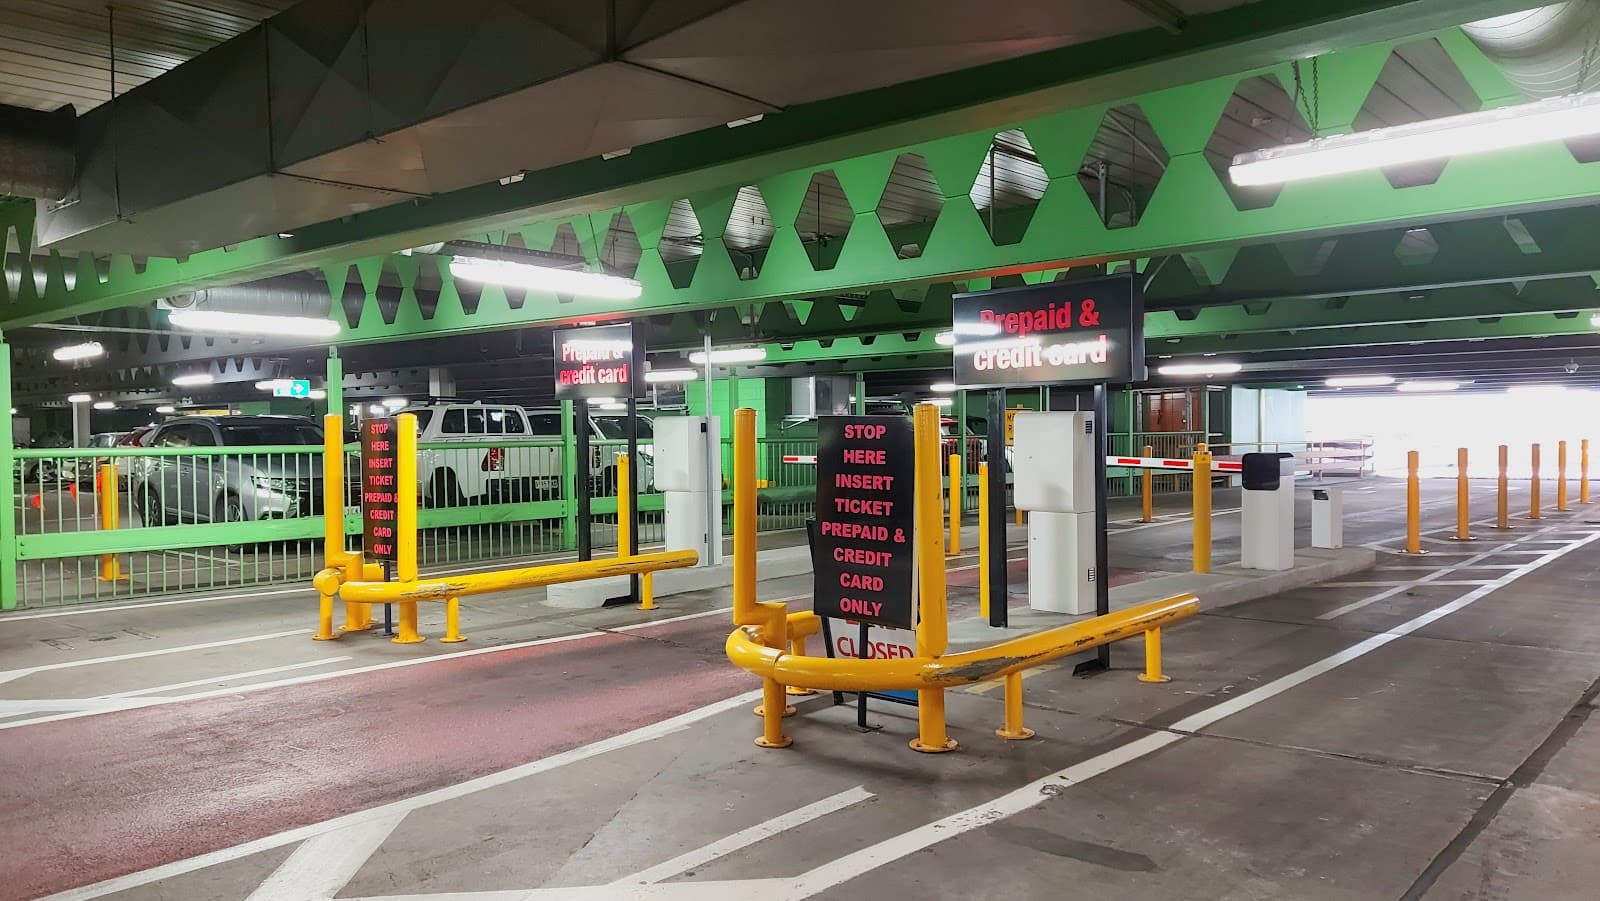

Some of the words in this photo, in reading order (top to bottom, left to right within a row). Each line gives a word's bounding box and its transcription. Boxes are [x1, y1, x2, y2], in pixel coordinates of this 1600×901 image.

[979, 301, 1072, 338] Prepaid
[1079, 299, 1099, 327] &
[973, 341, 1042, 371] credit
[1048, 335, 1107, 366] card
[560, 365, 596, 385] credit
[598, 363, 628, 383] card
[370, 423, 389, 434] STOP
[844, 424, 886, 440] STOP
[371, 440, 390, 452] HERE
[368, 457, 393, 469] INSERT
[843, 449, 886, 465] HERE
[369, 475, 394, 486] TICKET
[835, 474, 894, 491] INSERT
[364, 492, 393, 503] PREPAID
[370, 509, 395, 521] CREDIT
[834, 498, 894, 516] TICKET
[373, 526, 392, 538] CARD
[821, 521, 889, 541] PREPAID
[893, 528, 906, 543] &
[373, 543, 393, 555] ONLY
[833, 547, 893, 568] CREDIT
[840, 572, 884, 592] CARD
[839, 597, 882, 617] ONLY
[836, 636, 915, 659] CLOSED
